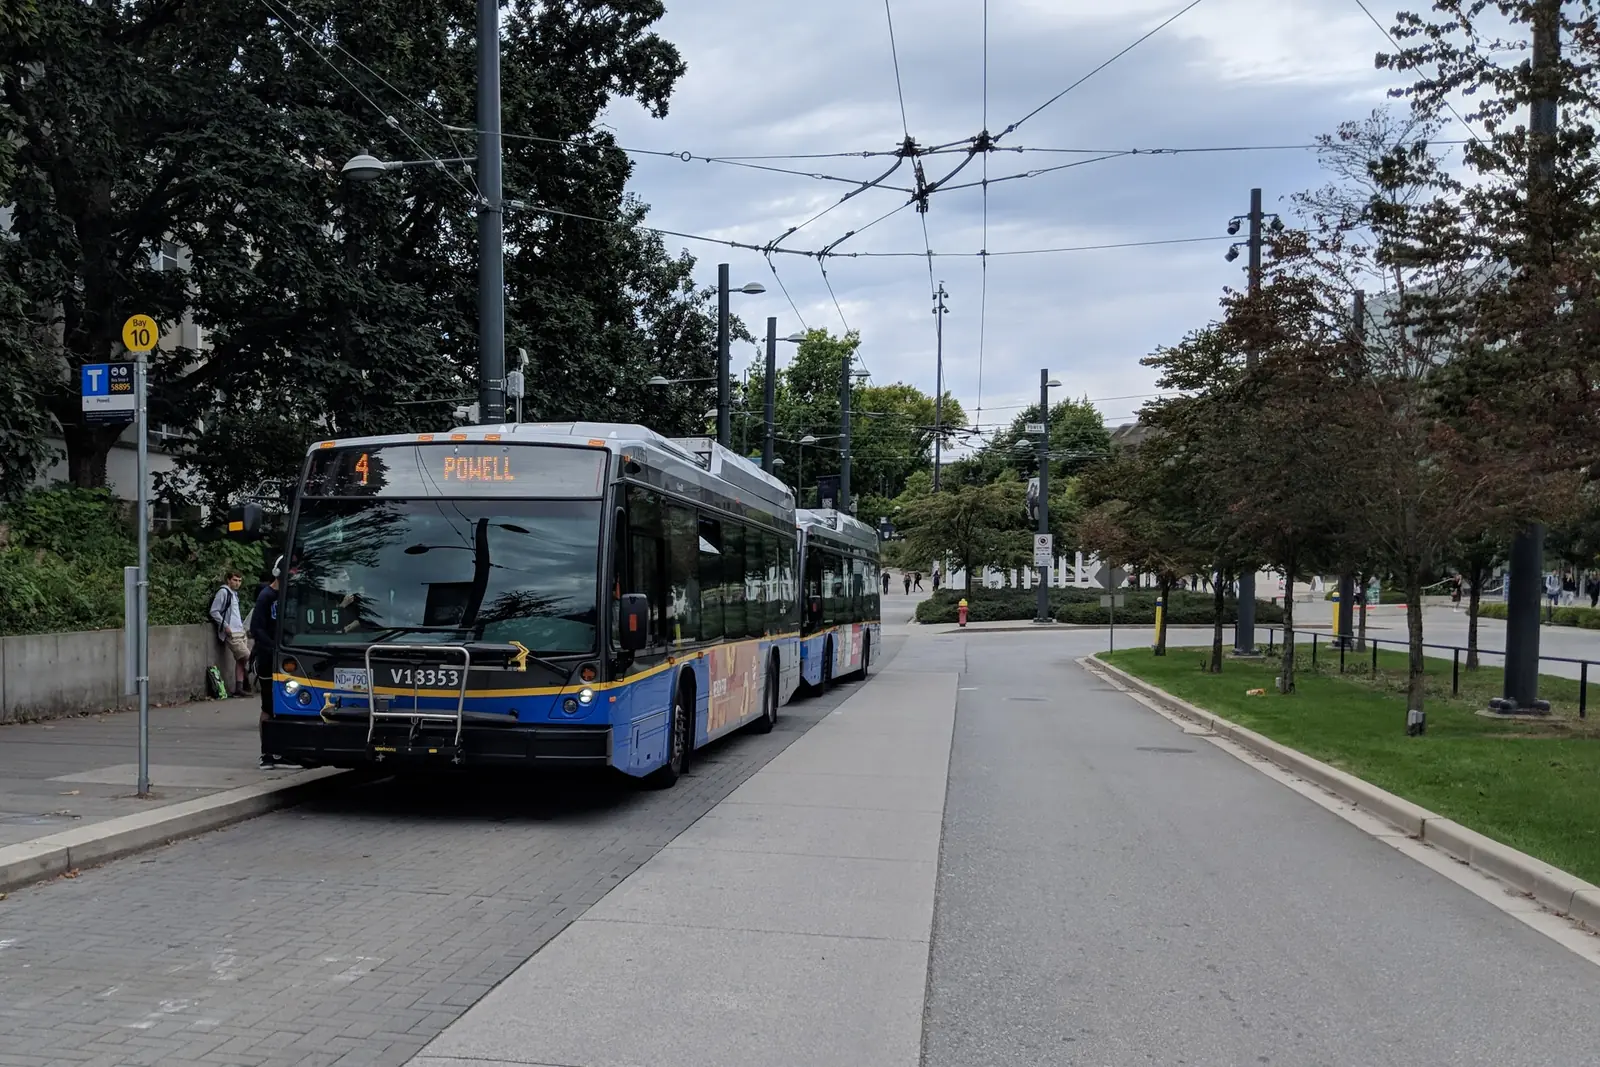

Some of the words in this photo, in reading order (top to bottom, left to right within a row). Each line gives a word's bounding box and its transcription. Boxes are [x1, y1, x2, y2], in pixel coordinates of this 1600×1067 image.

[132, 319, 147, 328] Bay
[130, 328, 150, 347] 10
[87, 369, 103, 391] T
[355, 453, 369, 484] 4
[444, 456, 516, 482] POWELL
[390, 668, 459, 687] V18353
